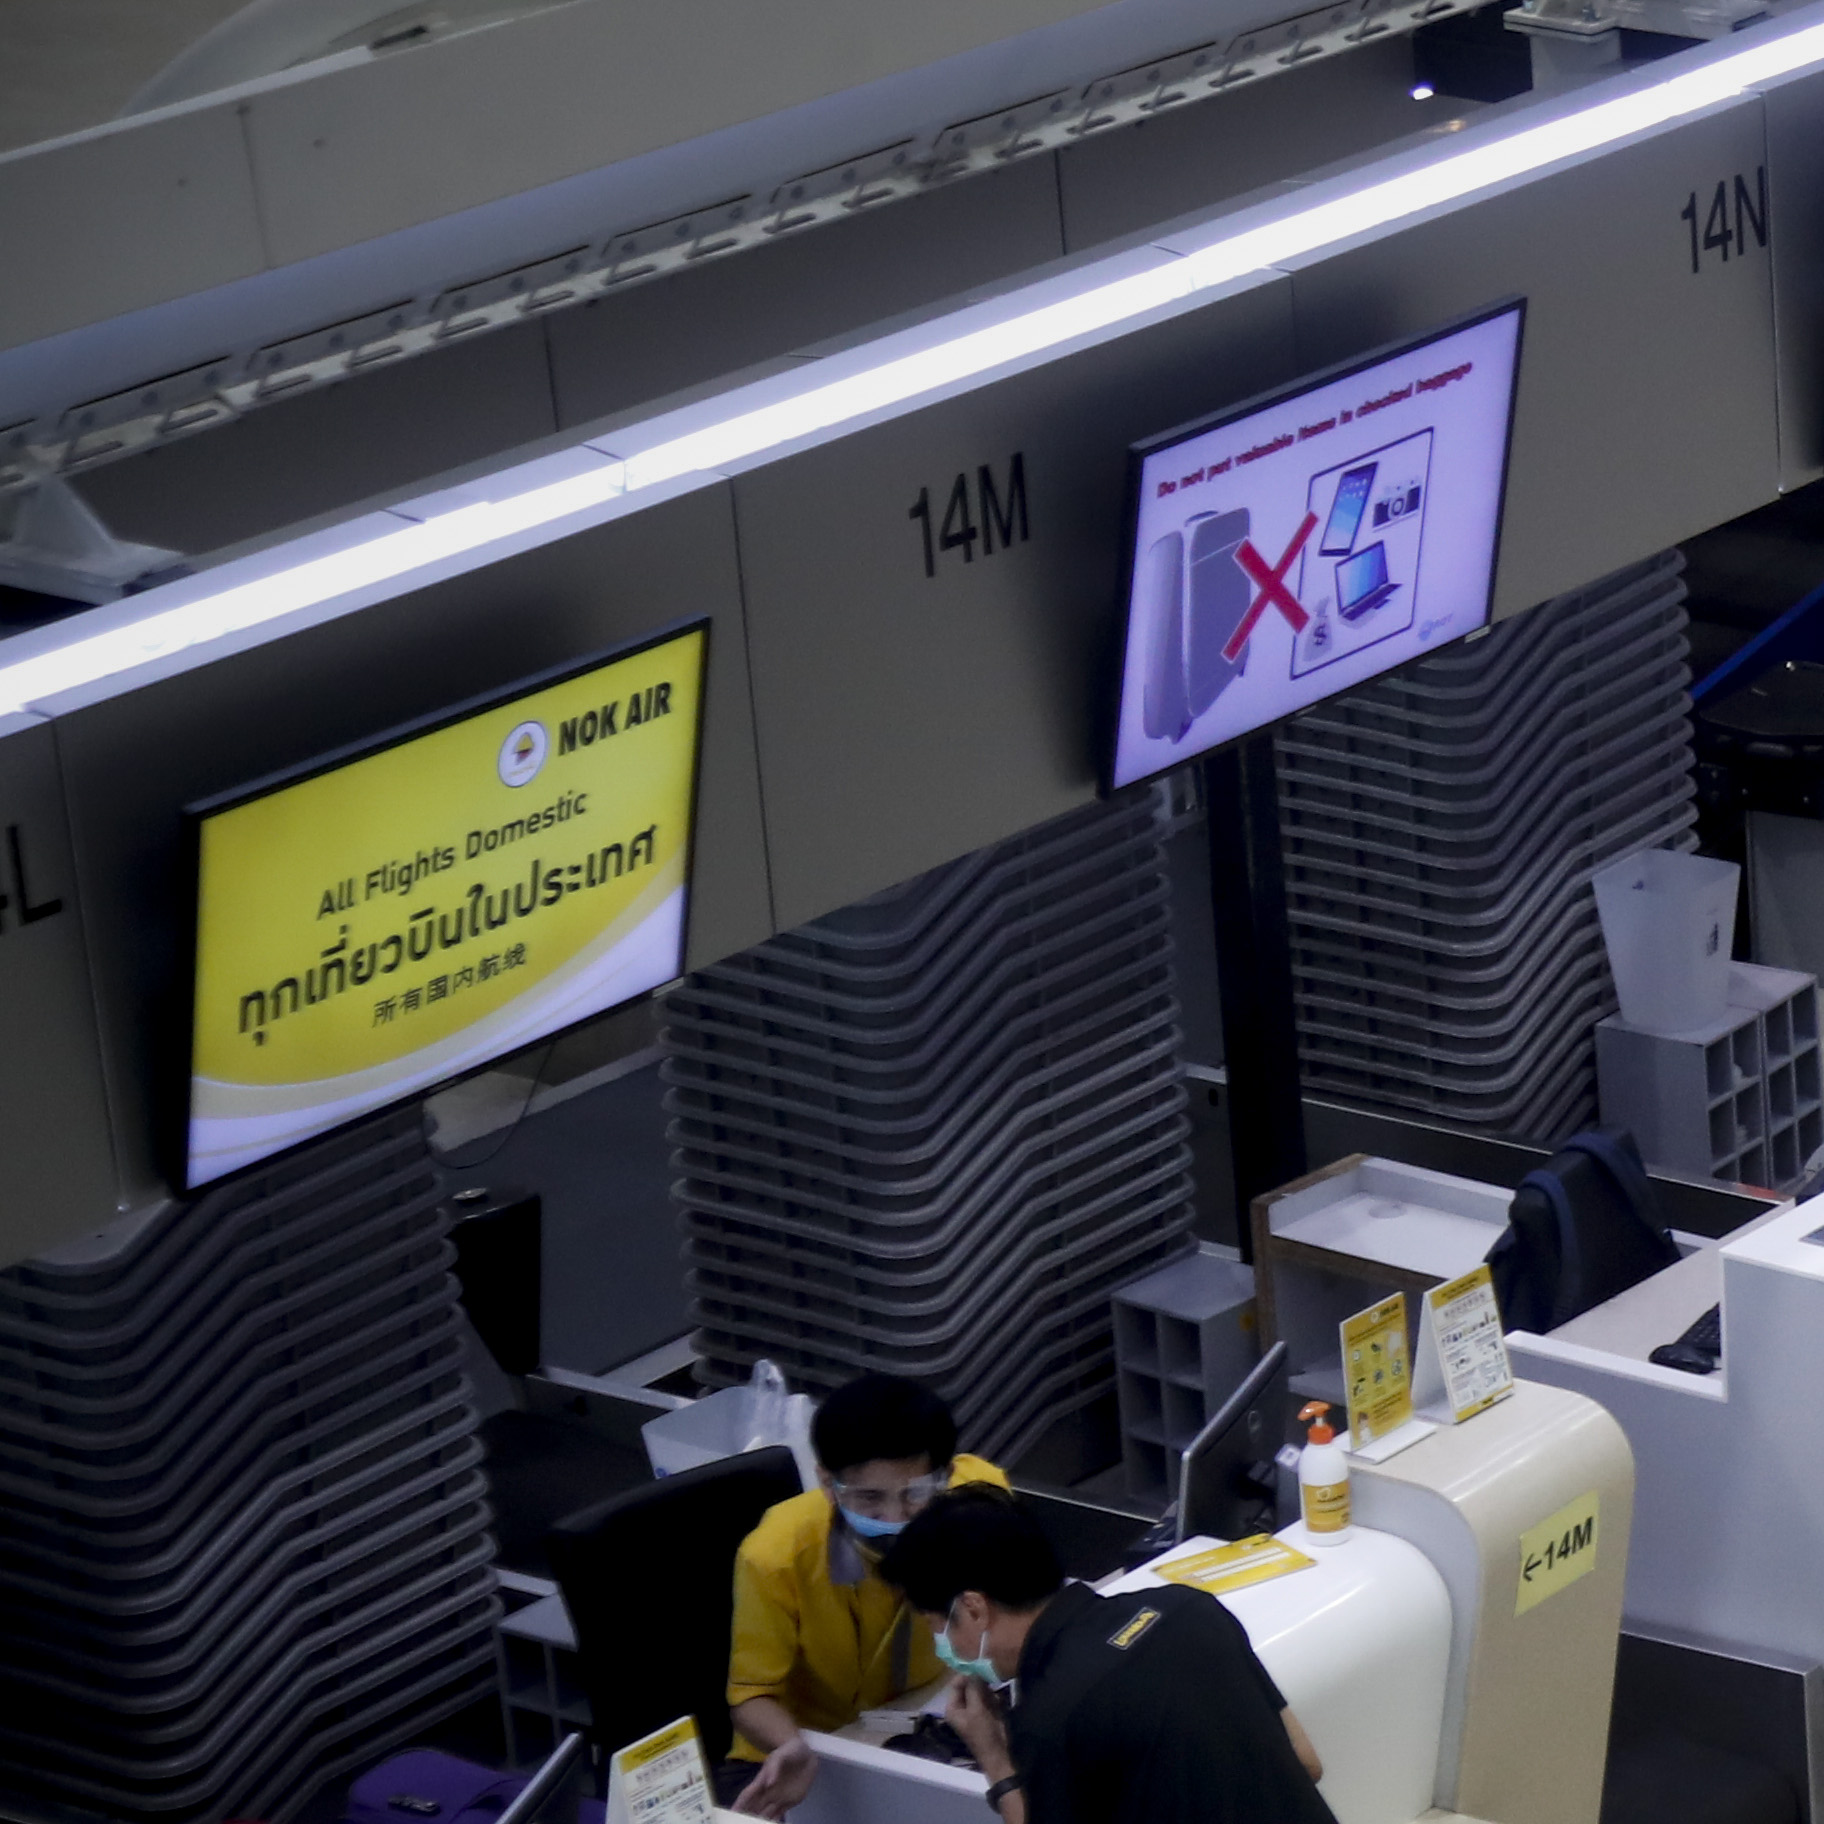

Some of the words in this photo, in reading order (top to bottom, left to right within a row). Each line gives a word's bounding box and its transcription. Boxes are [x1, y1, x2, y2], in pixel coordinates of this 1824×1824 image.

[1681, 165, 1768, 273] 14N
[909, 451, 1030, 578] 14M
[558, 701, 618, 756] NOK
[624, 682, 672, 730] AIR
[316, 878, 354, 920] All
[365, 847, 454, 900] Flights
[466, 790, 587, 860] Domestic
[238, 824, 658, 1047] ทุกเที่ยวบินในประเทศ
[372, 942, 527, 1028] 所有国内航线
[1543, 1515, 1593, 1574] 14M
